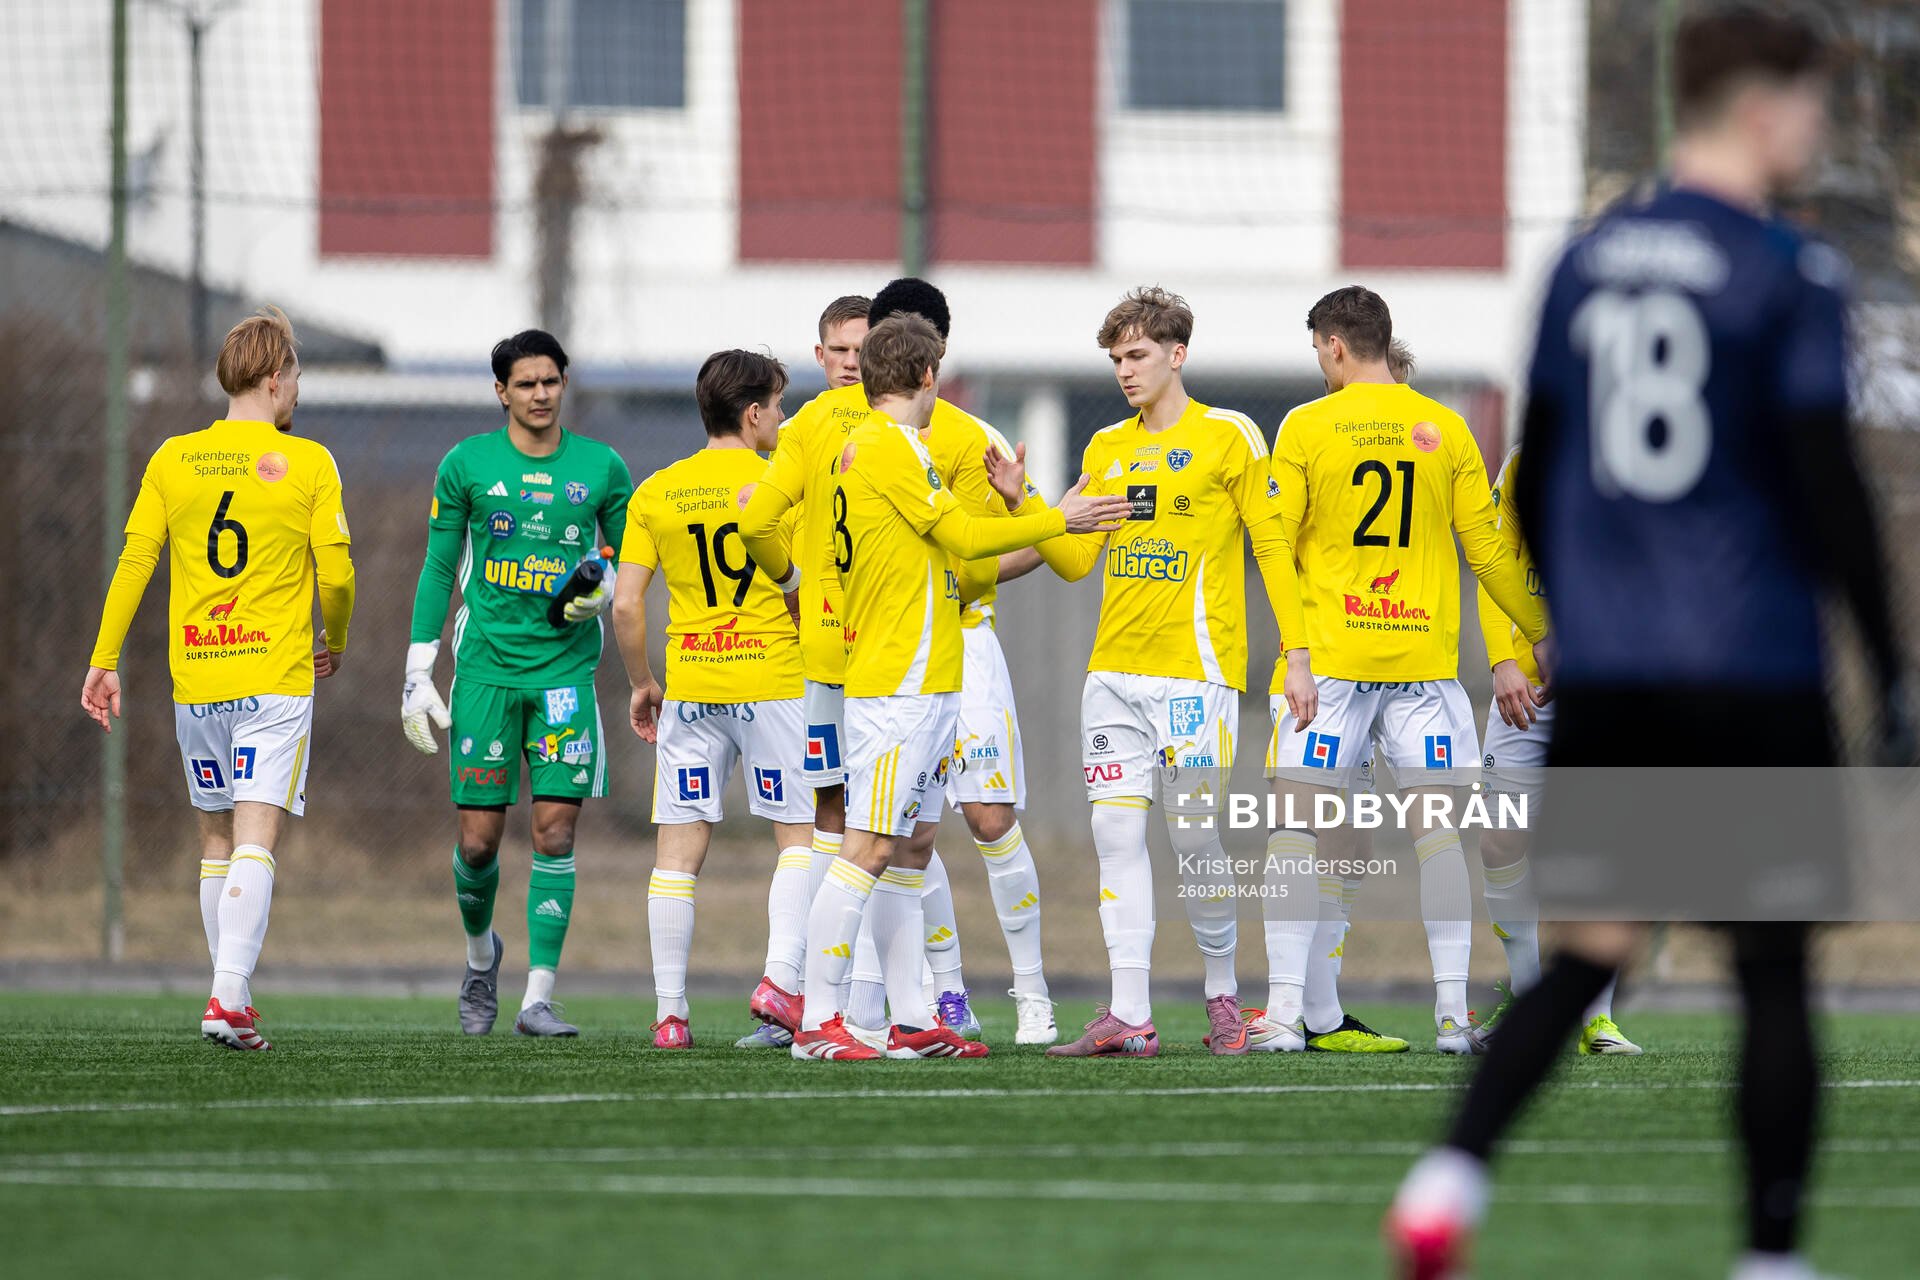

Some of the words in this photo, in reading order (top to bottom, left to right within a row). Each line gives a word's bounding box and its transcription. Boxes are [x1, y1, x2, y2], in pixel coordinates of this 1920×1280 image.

[1569, 290, 1712, 501] 18
[832, 408, 871, 420] Falken
[1335, 421, 1405, 433] Falkenbergs
[1351, 434, 1405, 447] Sparbank
[181, 451, 250, 464] Falkenbergs
[194, 464, 249, 477] Sparbank
[665, 485, 730, 501] Falkenbergs
[676, 499, 729, 514] Sparbank
[1352, 459, 1415, 548] 21
[207, 491, 248, 578] 6
[1131, 537, 1175, 558] Gekås
[523, 554, 567, 575] Gekås
[688, 522, 758, 608] 19
[1109, 546, 1188, 582] llared
[1343, 594, 1382, 619] Röda
[1380, 598, 1431, 621] Ulven
[1345, 620, 1430, 633] SURSTRÖMMING
[182, 624, 218, 647] Röda
[216, 624, 271, 646] Ulven
[680, 632, 717, 652] Röda
[712, 631, 767, 653] Ulven
[186, 646, 268, 661] SURSTRÖMMING
[679, 653, 766, 664] SURSTRÖMMING
[1172, 699, 1198, 711] EFF
[1172, 710, 1202, 722] EKT
[970, 746, 999, 759] SKAB
[1184, 755, 1214, 767] SKAB
